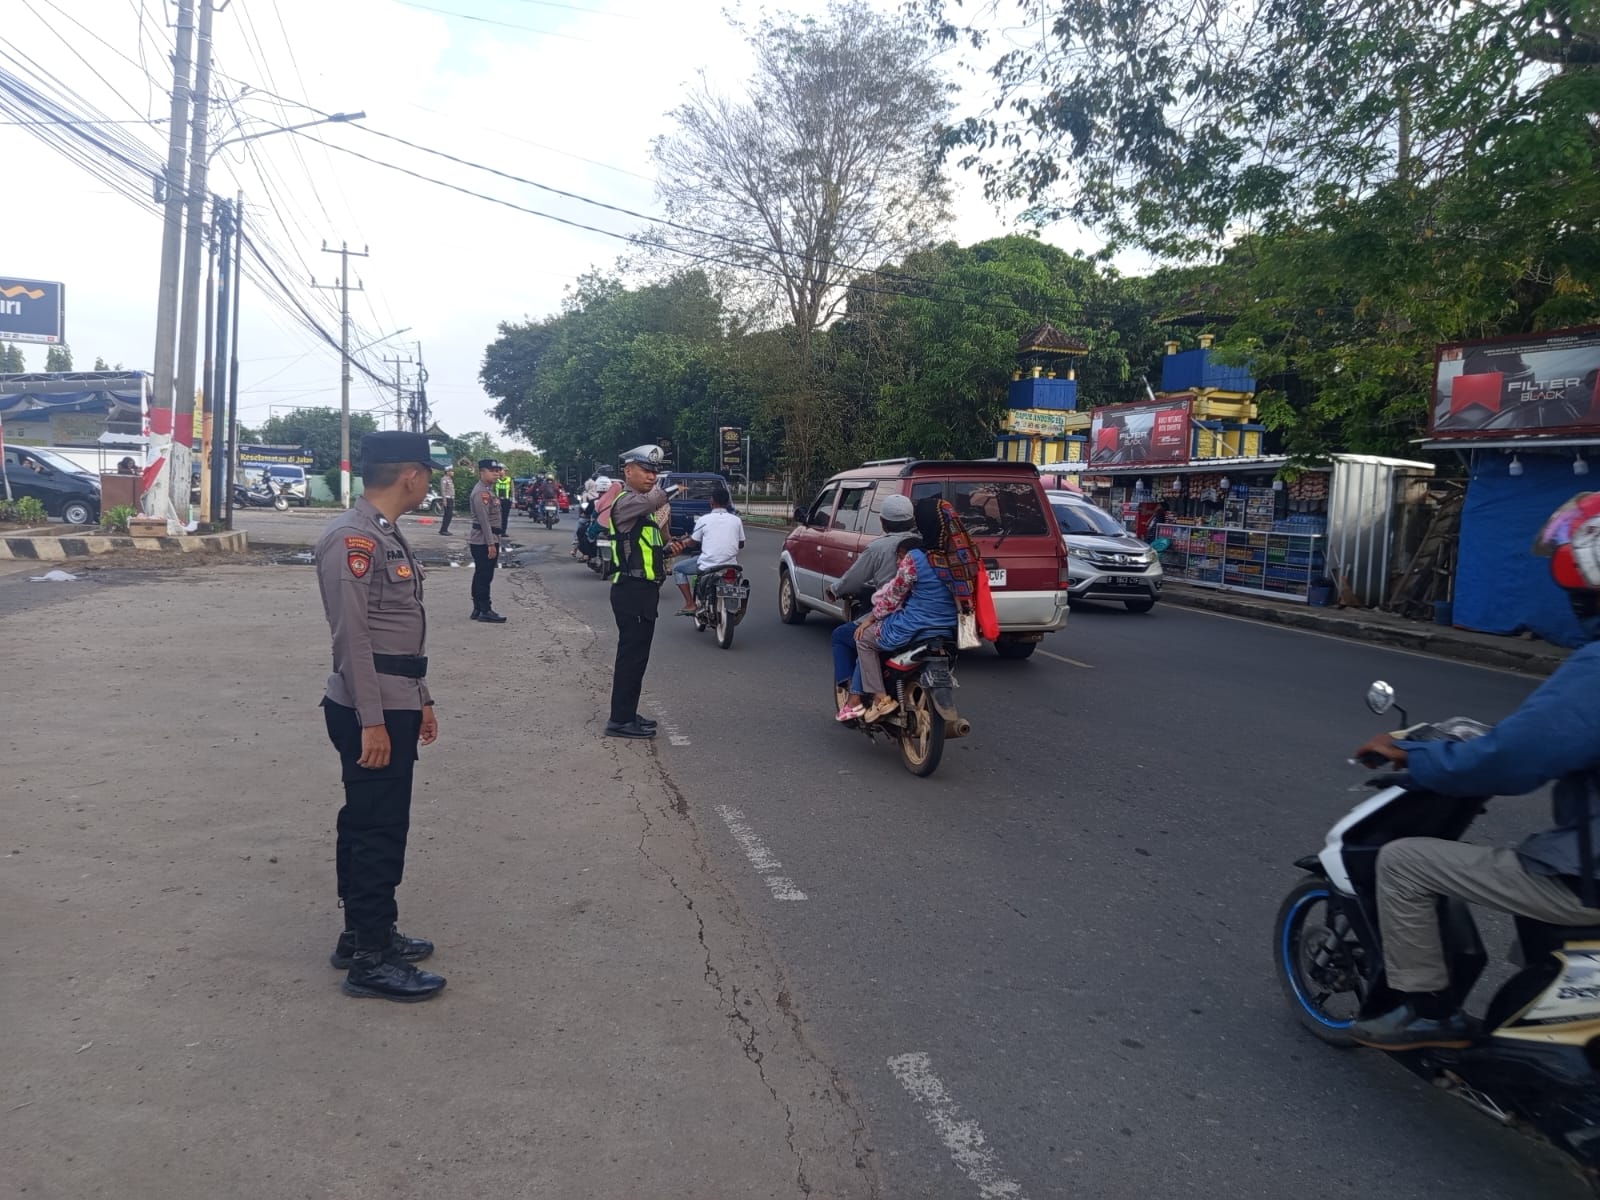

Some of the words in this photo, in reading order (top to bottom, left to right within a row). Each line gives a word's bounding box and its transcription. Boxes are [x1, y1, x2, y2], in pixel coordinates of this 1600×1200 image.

[1508, 377, 1581, 392] FILTER
[1520, 390, 1565, 402] BLACK
[1119, 431, 1148, 440] FILTER
[287, 455, 295, 463] di
